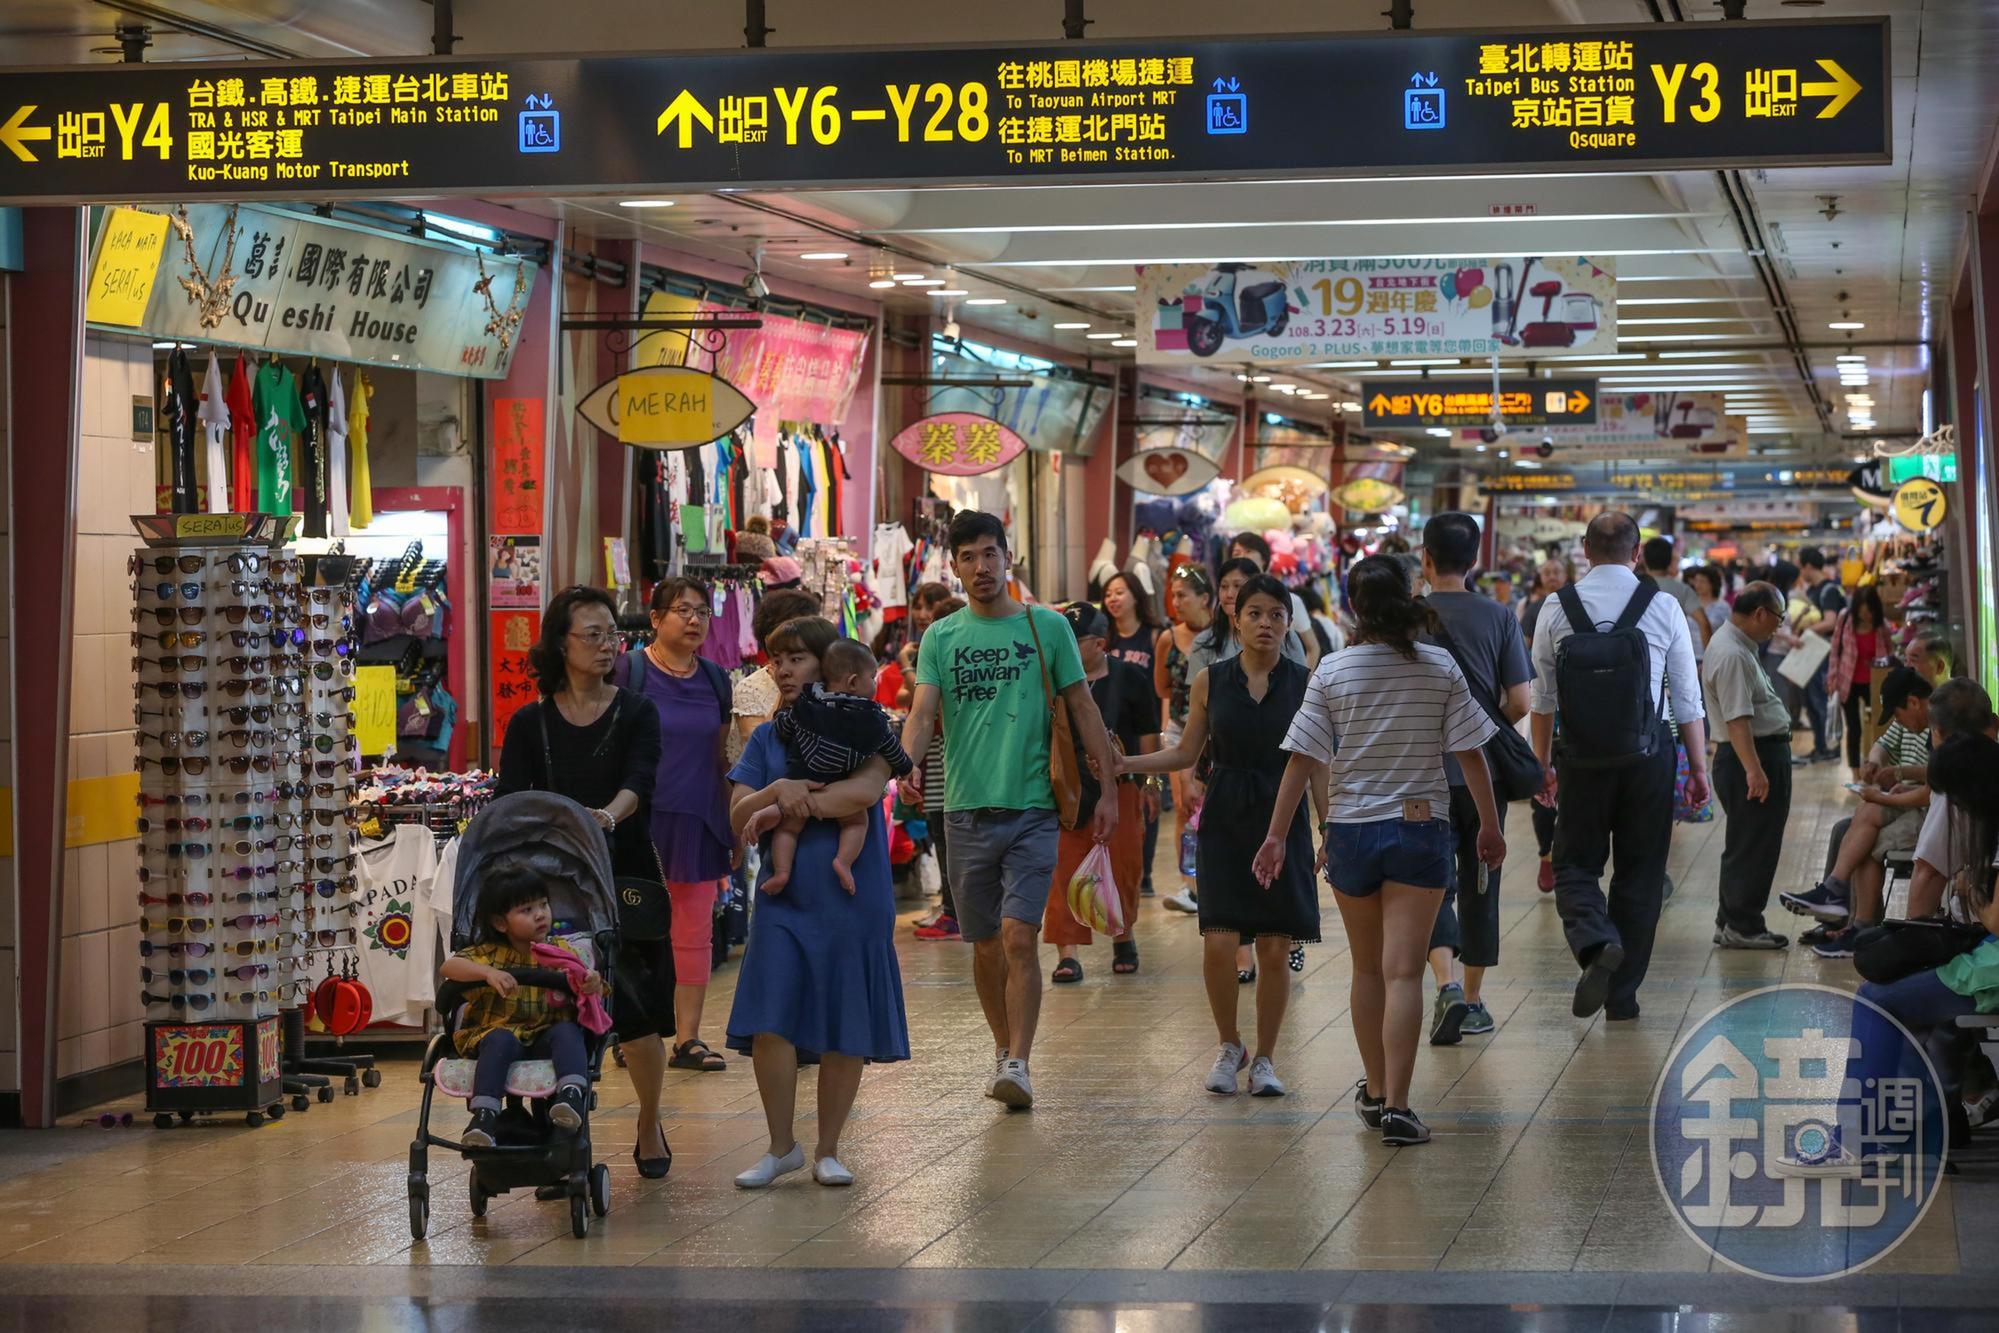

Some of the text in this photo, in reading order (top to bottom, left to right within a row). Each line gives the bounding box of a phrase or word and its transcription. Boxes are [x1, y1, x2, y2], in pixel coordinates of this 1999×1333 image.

[1479, 41, 1633, 75] 臺北轉運站
[998, 57, 1193, 89] 往桃園機場捷運
[1466, 75, 1635, 96] Taipei Bus Station
[1651, 62, 1722, 123] Y3
[1745, 69, 1798, 118] 出口
[1006, 91, 1177, 109] To Taoyuan Airport MRT
[1772, 103, 1798, 117] EXIT
[189, 106, 498, 128] TRA & HSR & MRT Taipei Main Station
[718, 96, 768, 143] 出口
[1511, 96, 1635, 128] 京站百貨
[57, 112, 105, 158] 出口
[110, 103, 173, 160] Y4
[744, 131, 768, 143] EXIT
[998, 113, 1166, 144] 往捷運北門站
[187, 130, 304, 160] 國光客運
[1570, 131, 1636, 149] Qsquare
[82, 145, 105, 158] EXIT
[1008, 150, 1023, 163] To
[1030, 149, 1054, 162] MRT
[1061, 148, 1107, 162] Beimen
[188, 160, 409, 181] Kuo-Kuang Motor Transport
[349, 310, 418, 344] House
[1251, 343, 1302, 357] Gogoro
[1310, 344, 1317, 356] 2
[627, 393, 706, 417] MERAH
[1413, 393, 1443, 416] Y6
[954, 647, 1010, 669] Keep
[950, 664, 1021, 686] Taiwan
[954, 684, 997, 705] Free
